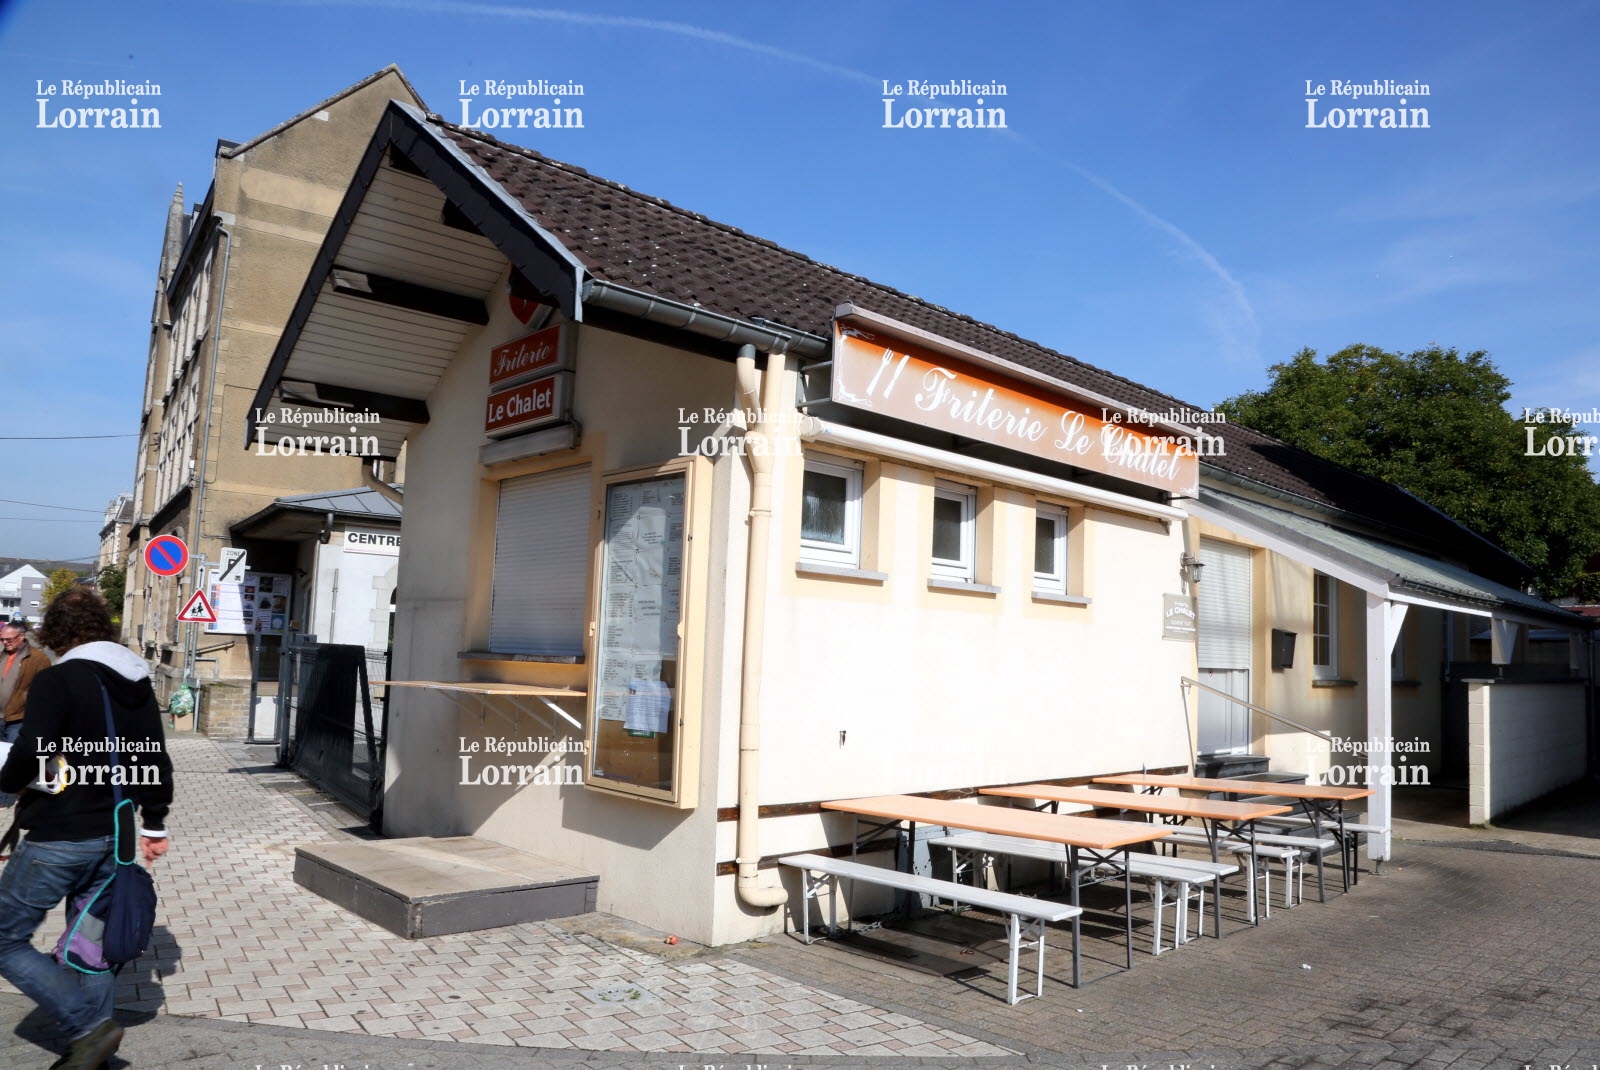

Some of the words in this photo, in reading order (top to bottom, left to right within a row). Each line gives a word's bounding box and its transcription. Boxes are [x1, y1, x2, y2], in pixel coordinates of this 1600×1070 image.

[493, 341, 552, 377] Friterie
[488, 403, 503, 423] Le
[506, 387, 552, 418] Chalet
[915, 367, 1048, 442] Friterie
[1054, 410, 1095, 456] Le
[1100, 424, 1181, 480] Chalet
[348, 533, 401, 546] CENTRE
[1166, 608, 1174, 618] LE
[1174, 607, 1195, 620] CHALET
